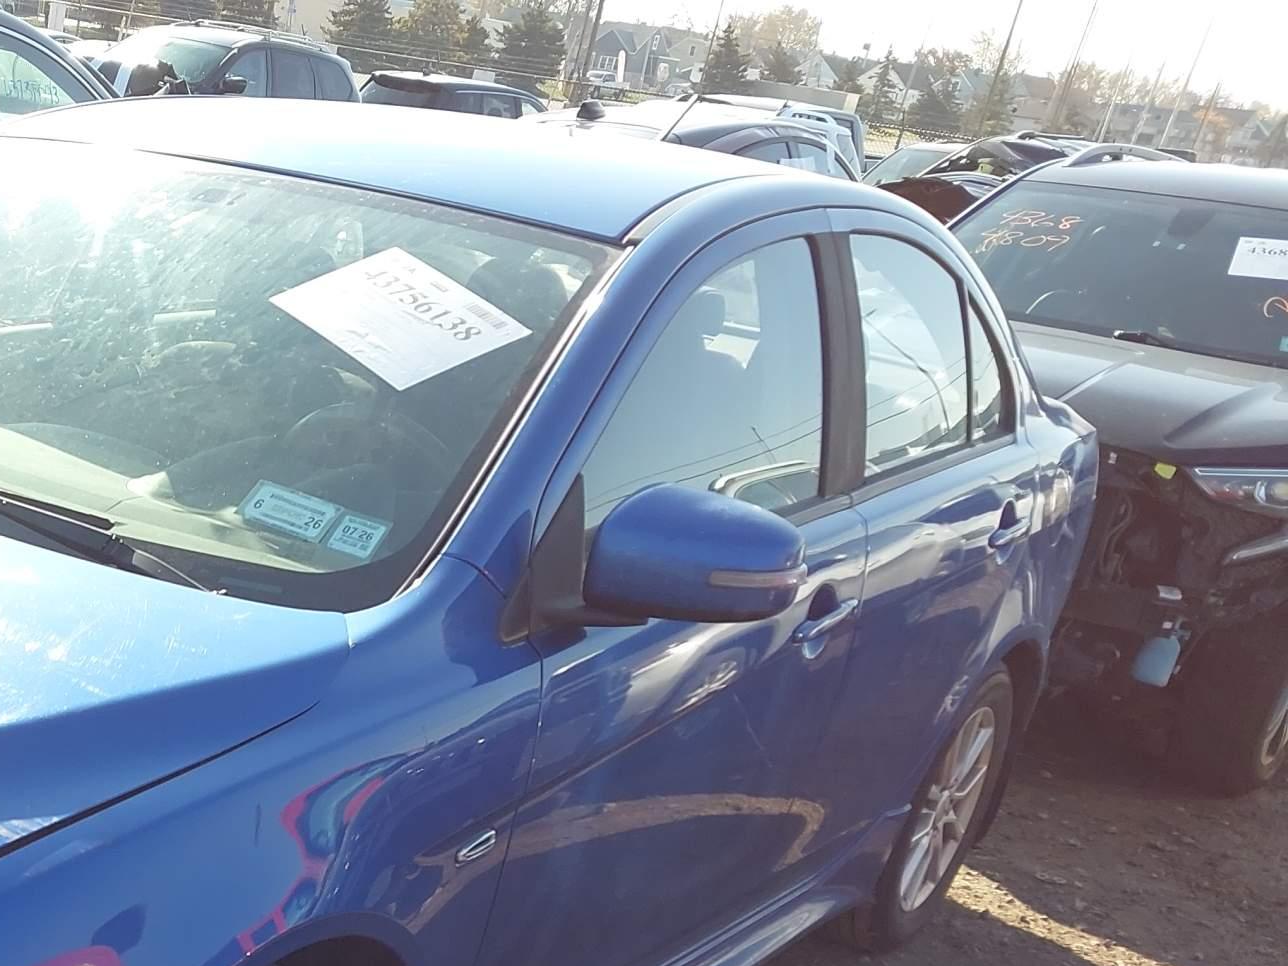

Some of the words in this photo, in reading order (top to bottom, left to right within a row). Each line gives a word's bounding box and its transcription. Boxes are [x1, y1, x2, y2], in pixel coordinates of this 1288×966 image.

[364, 271, 482, 342] 43756138
[253, 498, 265, 510] 6
[303, 516, 323, 530] 26
